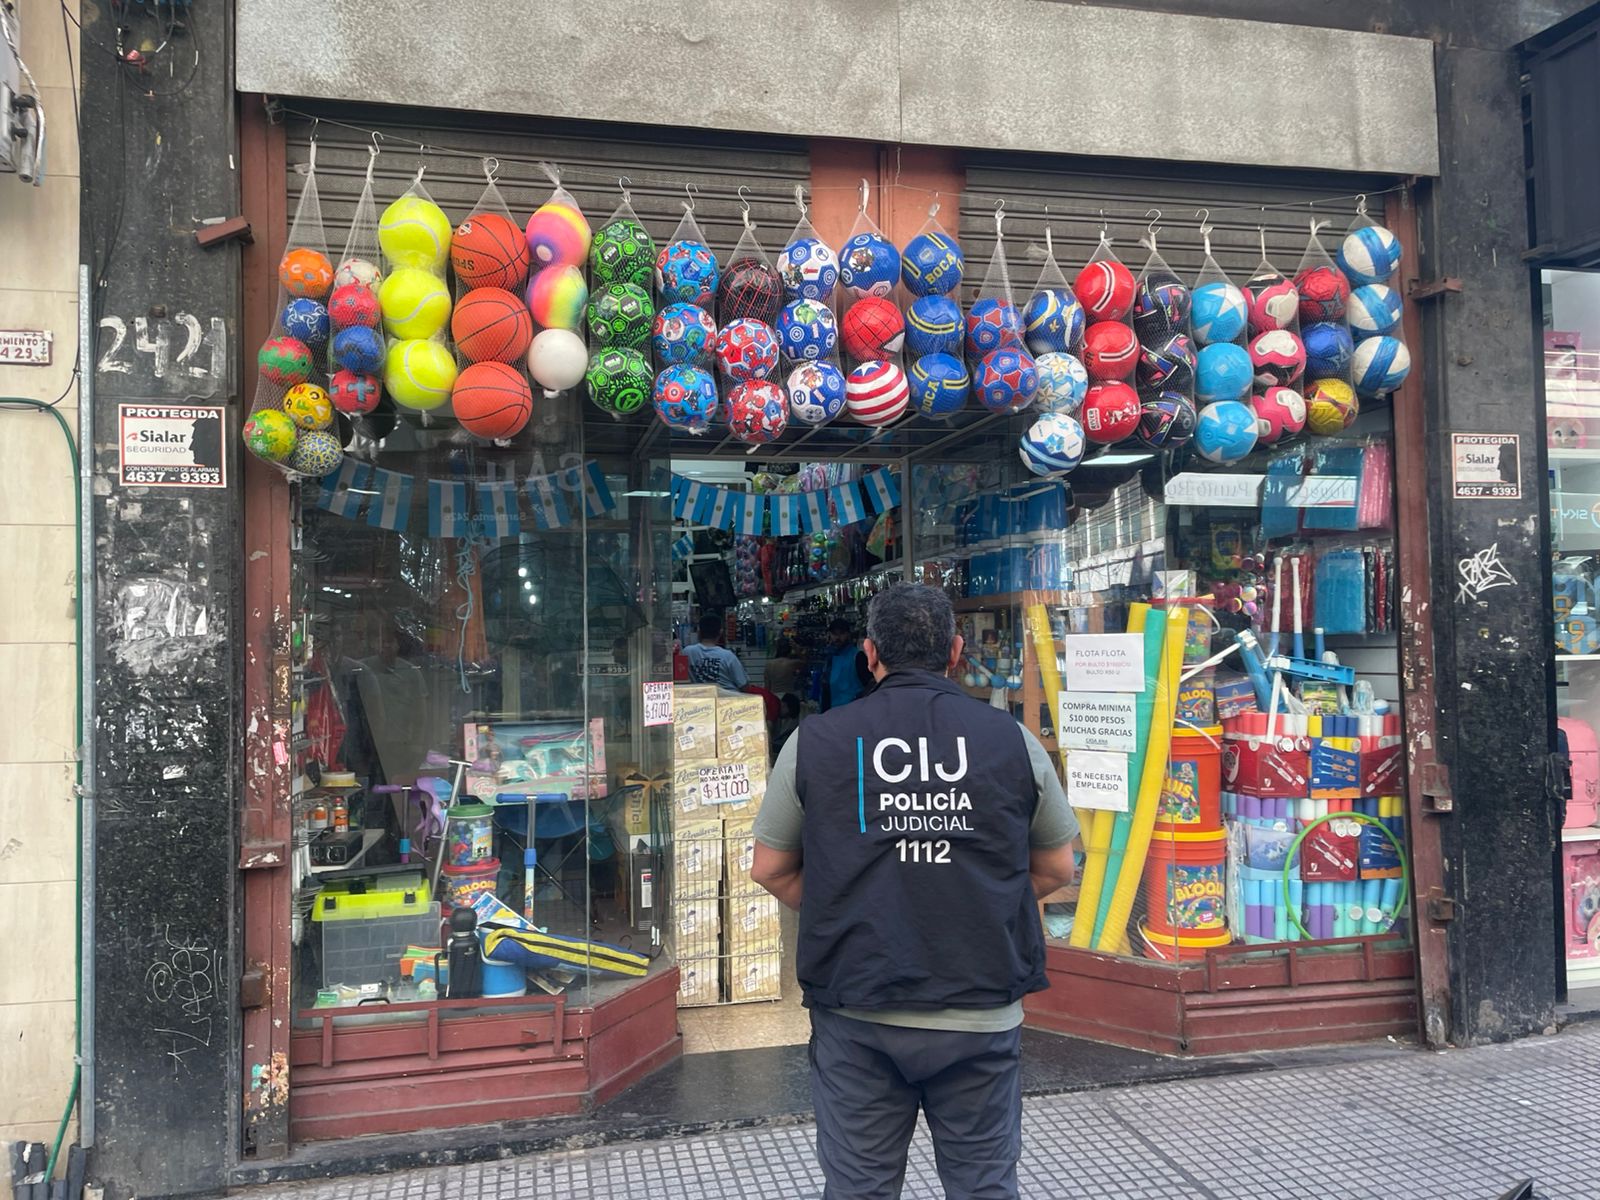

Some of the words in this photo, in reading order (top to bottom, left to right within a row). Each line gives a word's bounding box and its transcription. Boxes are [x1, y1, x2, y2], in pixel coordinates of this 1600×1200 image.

[925, 252, 957, 285] BOCA
[98, 312, 227, 378] 2421
[921, 381, 940, 413] BOCA
[126, 408, 219, 419] PROTEGIDA
[140, 430, 186, 443] Sialar
[1456, 436, 1516, 445] PROTEGIDA
[126, 446, 187, 454] SEGURIDAD
[1466, 453, 1495, 464] Sialar
[126, 472, 166, 482] 4637
[180, 473, 220, 484] 9393
[1457, 487, 1484, 496] 4637
[1492, 487, 1517, 496] 9393
[1062, 702, 1097, 711] COMPRA
[1098, 704, 1132, 712] MINIMA
[1069, 714, 1083, 722] $10
[1084, 715, 1099, 723] 000
[1100, 716, 1126, 724] PESOS
[1062, 726, 1097, 735] MUCHAS
[1098, 728, 1133, 737] GRACIAS
[873, 737, 968, 783] CIJ
[1084, 773, 1123, 782] NECESITA
[1076, 781, 1119, 791] EMPLEADO
[880, 788, 973, 811] POLICÍA
[881, 816, 974, 831] JUDICIAL
[896, 839, 951, 864] 1112
